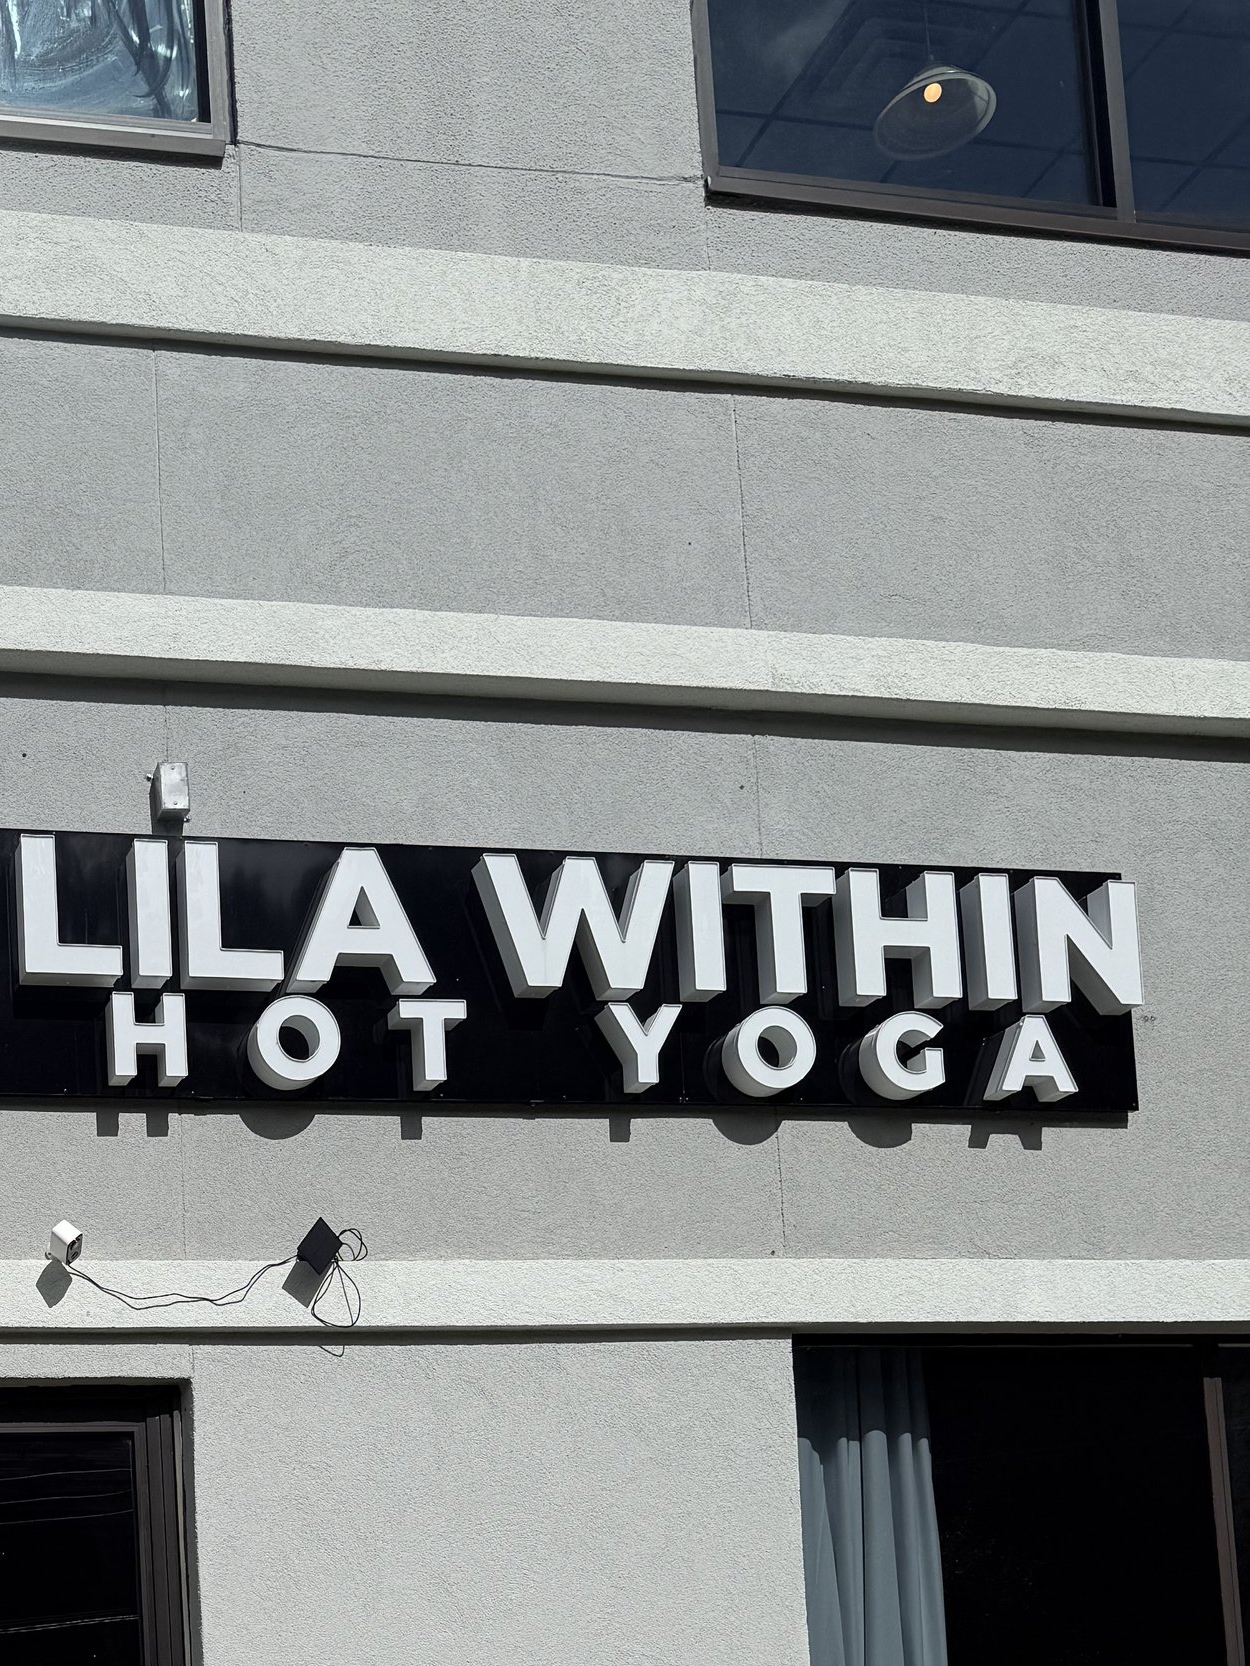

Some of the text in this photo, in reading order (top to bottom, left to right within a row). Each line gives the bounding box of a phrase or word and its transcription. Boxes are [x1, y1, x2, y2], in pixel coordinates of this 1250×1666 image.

[18, 834, 1142, 1015] LILA WITHIN
[107, 992, 1078, 1101] HOT YOGA
